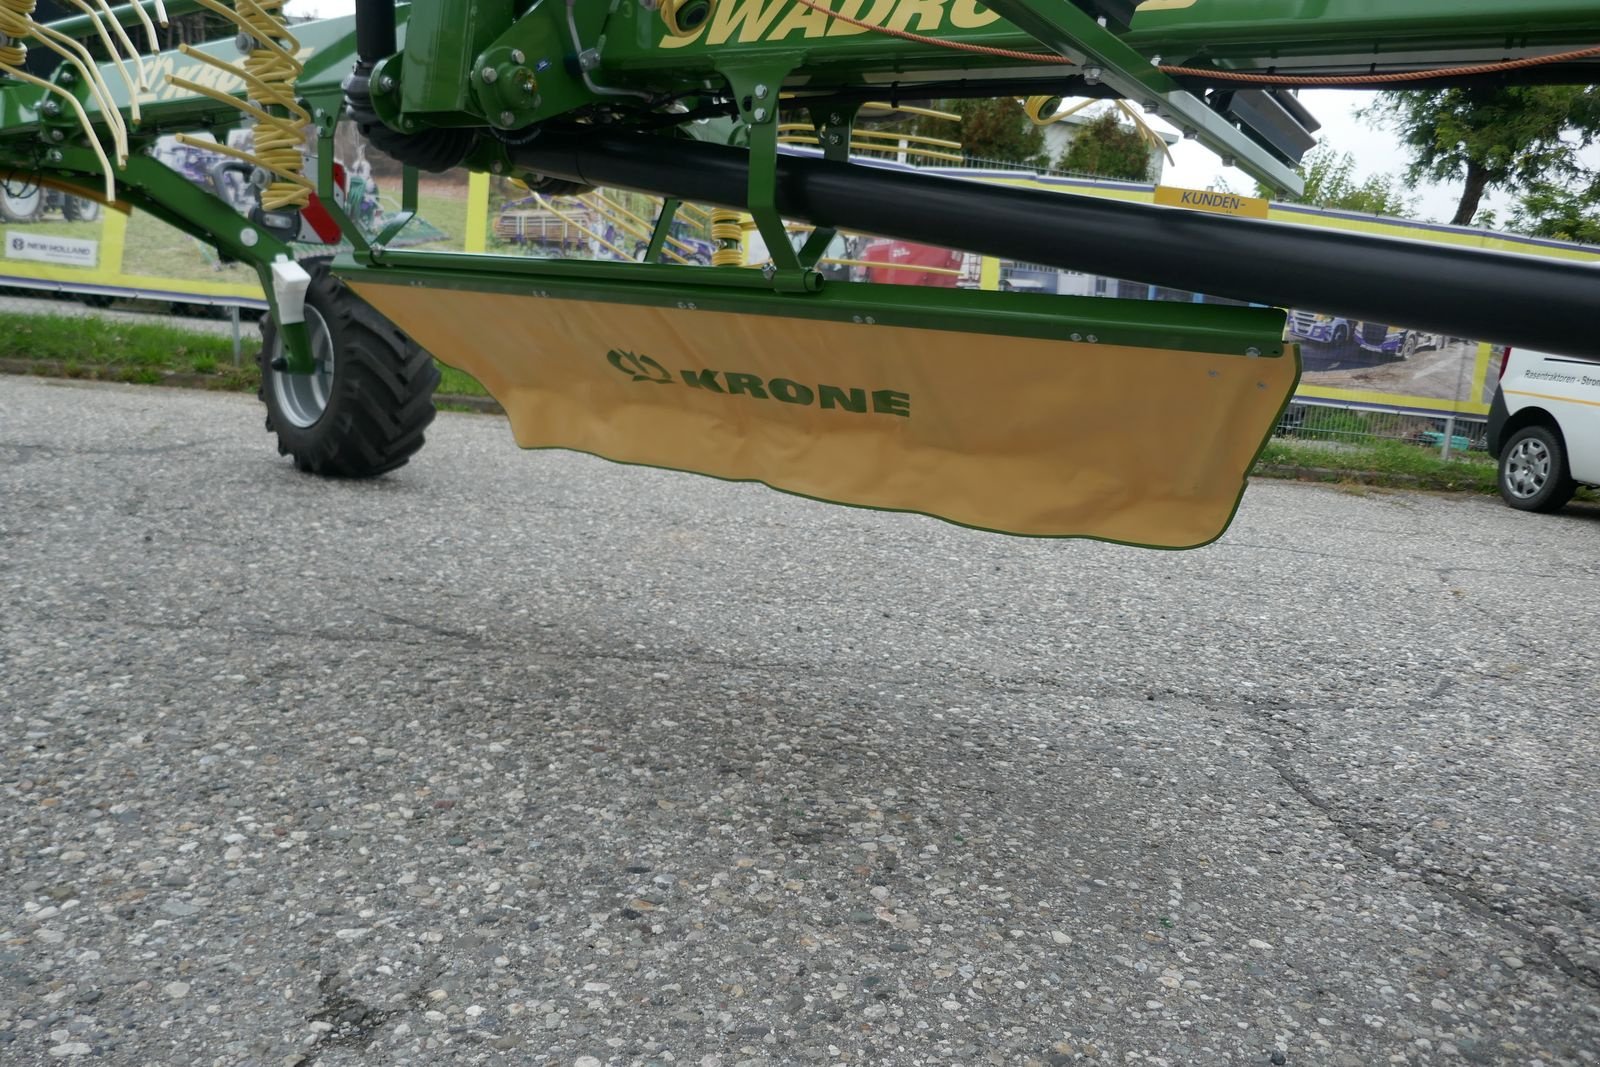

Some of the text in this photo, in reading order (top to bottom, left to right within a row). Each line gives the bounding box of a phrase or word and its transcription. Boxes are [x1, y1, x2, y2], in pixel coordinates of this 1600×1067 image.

[658, 0, 1001, 48] WADR
[1182, 191, 1246, 209] KUNDEN-
[27, 242, 91, 255] NEW HOLLAND
[680, 368, 910, 417] KRONE
